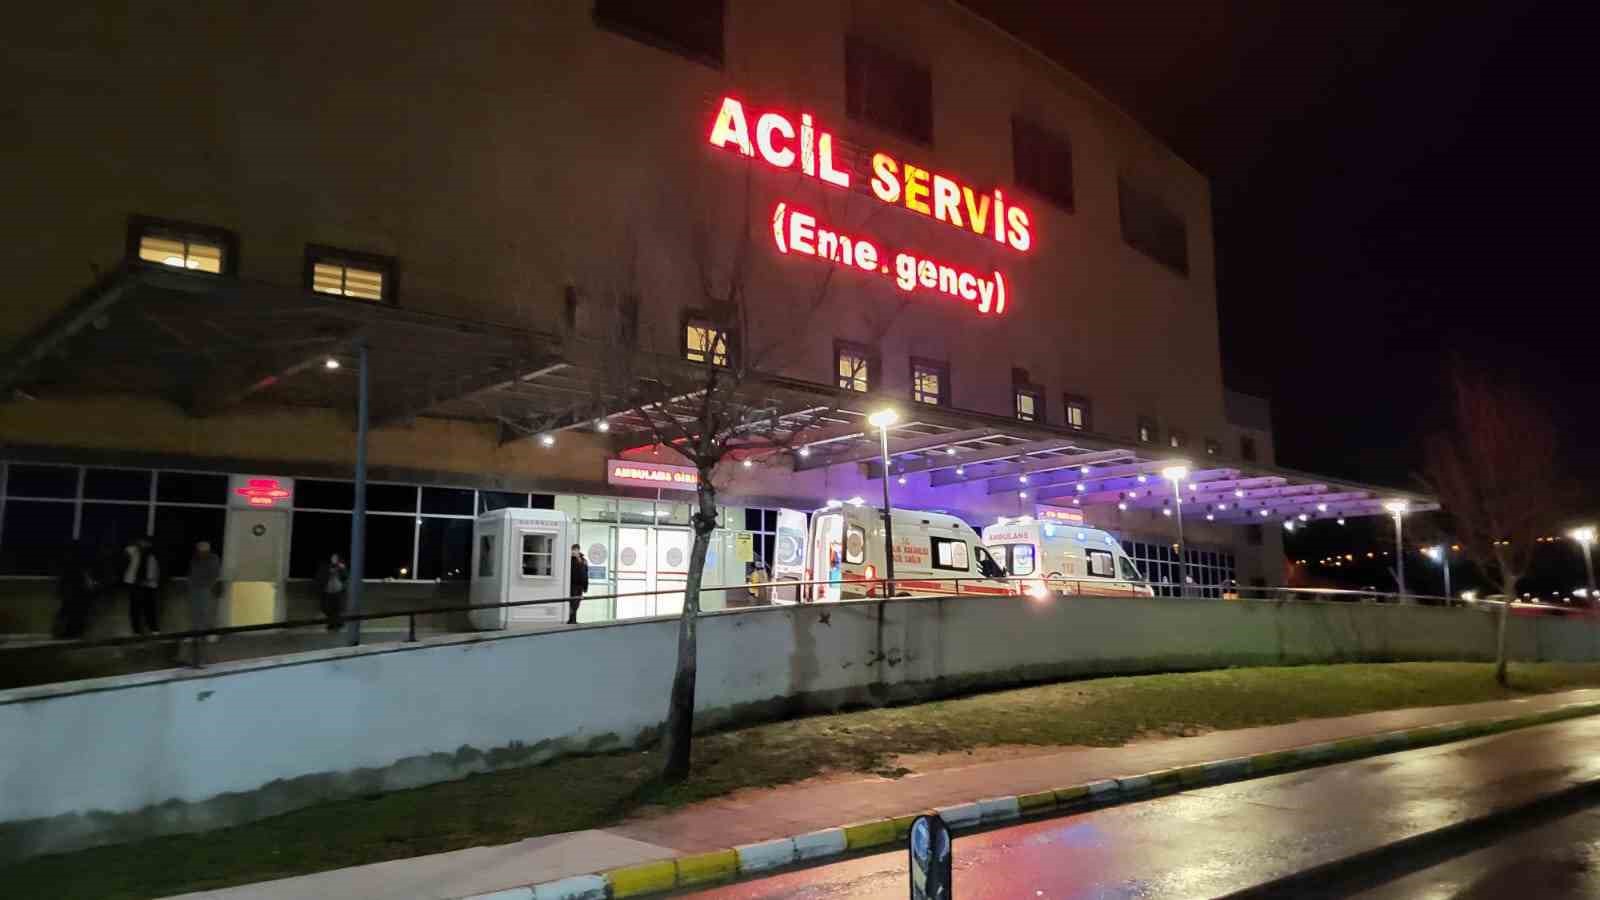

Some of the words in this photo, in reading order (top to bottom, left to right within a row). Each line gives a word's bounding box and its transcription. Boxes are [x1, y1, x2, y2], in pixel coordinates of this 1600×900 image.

[710, 97, 849, 188] ACİL
[871, 153, 1030, 251] SERVİS
[773, 202, 1005, 314] (Emegency)
